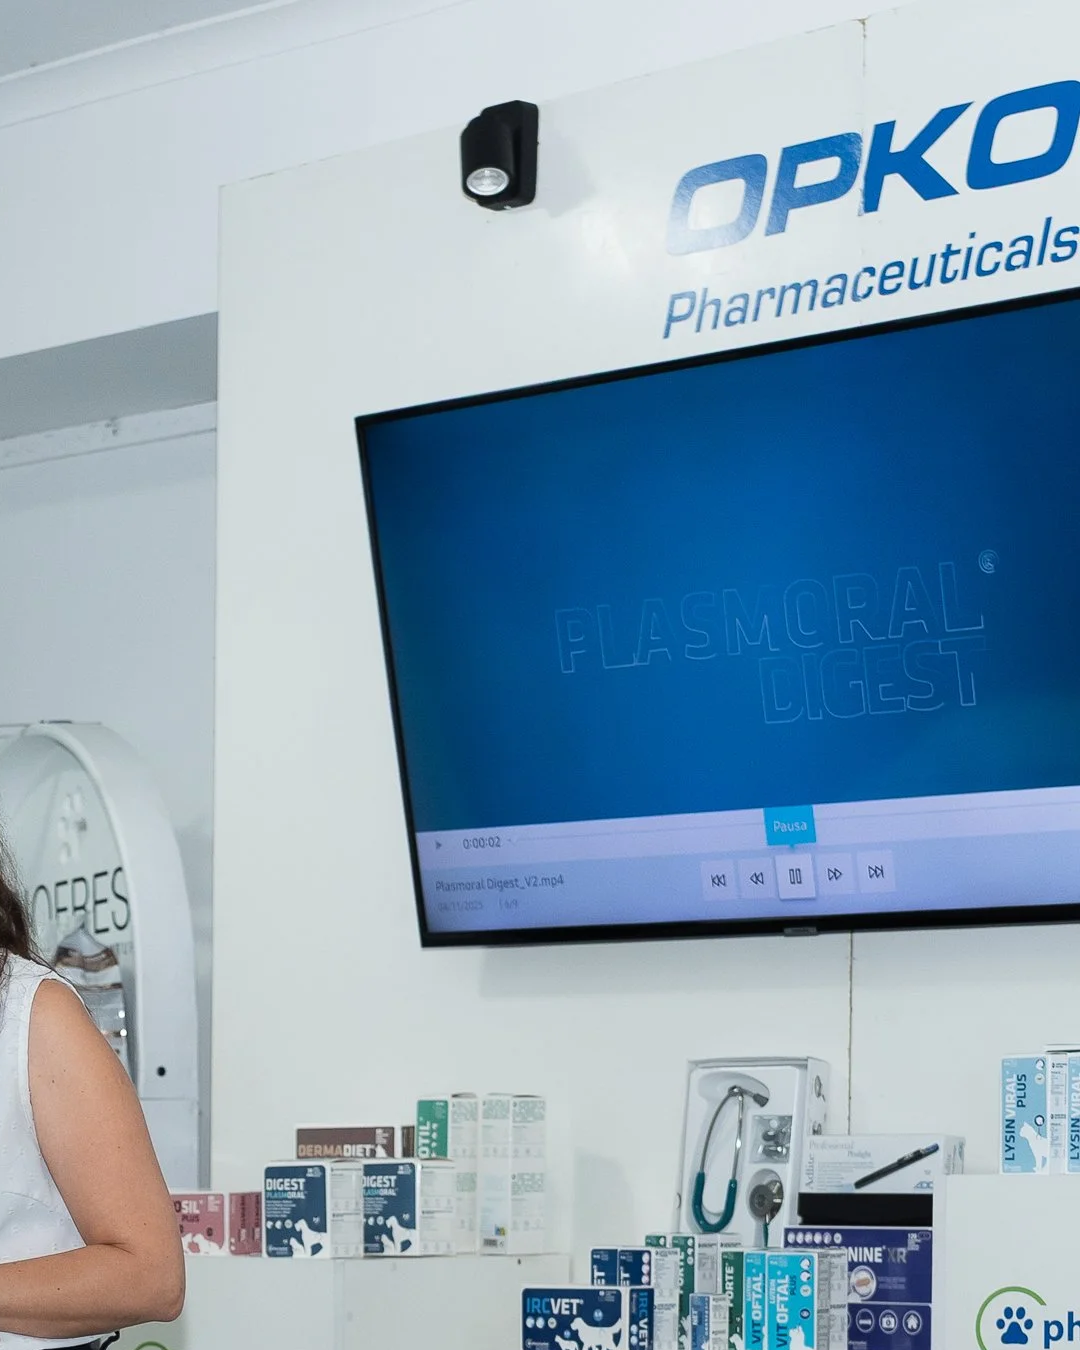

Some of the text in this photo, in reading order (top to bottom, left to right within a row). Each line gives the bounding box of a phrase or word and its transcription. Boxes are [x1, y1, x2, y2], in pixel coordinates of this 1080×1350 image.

[665, 80, 1080, 257] OPKO
[662, 216, 1080, 339] Pharmaceuticals
[554, 562, 985, 674] PLASMORAL
[759, 635, 986, 724] DIGEST
[773, 819, 808, 832] Pausa
[463, 836, 501, 850] 0:00:02
[435, 873, 565, 892] Plasmoral Digest_V2.mp4
[1016, 1073, 1027, 1108] PLUS
[298, 1143, 375, 1158] DERMADIET
[265, 1178, 306, 1191] DIGEST
[362, 1175, 397, 1188] DIGEST
[362, 1187, 397, 1197] LASMORAL
[526, 1297, 581, 1315] IRCVET
[751, 1272, 763, 1345] VITOFTAL
[776, 1274, 790, 1349] VITOFTAL
